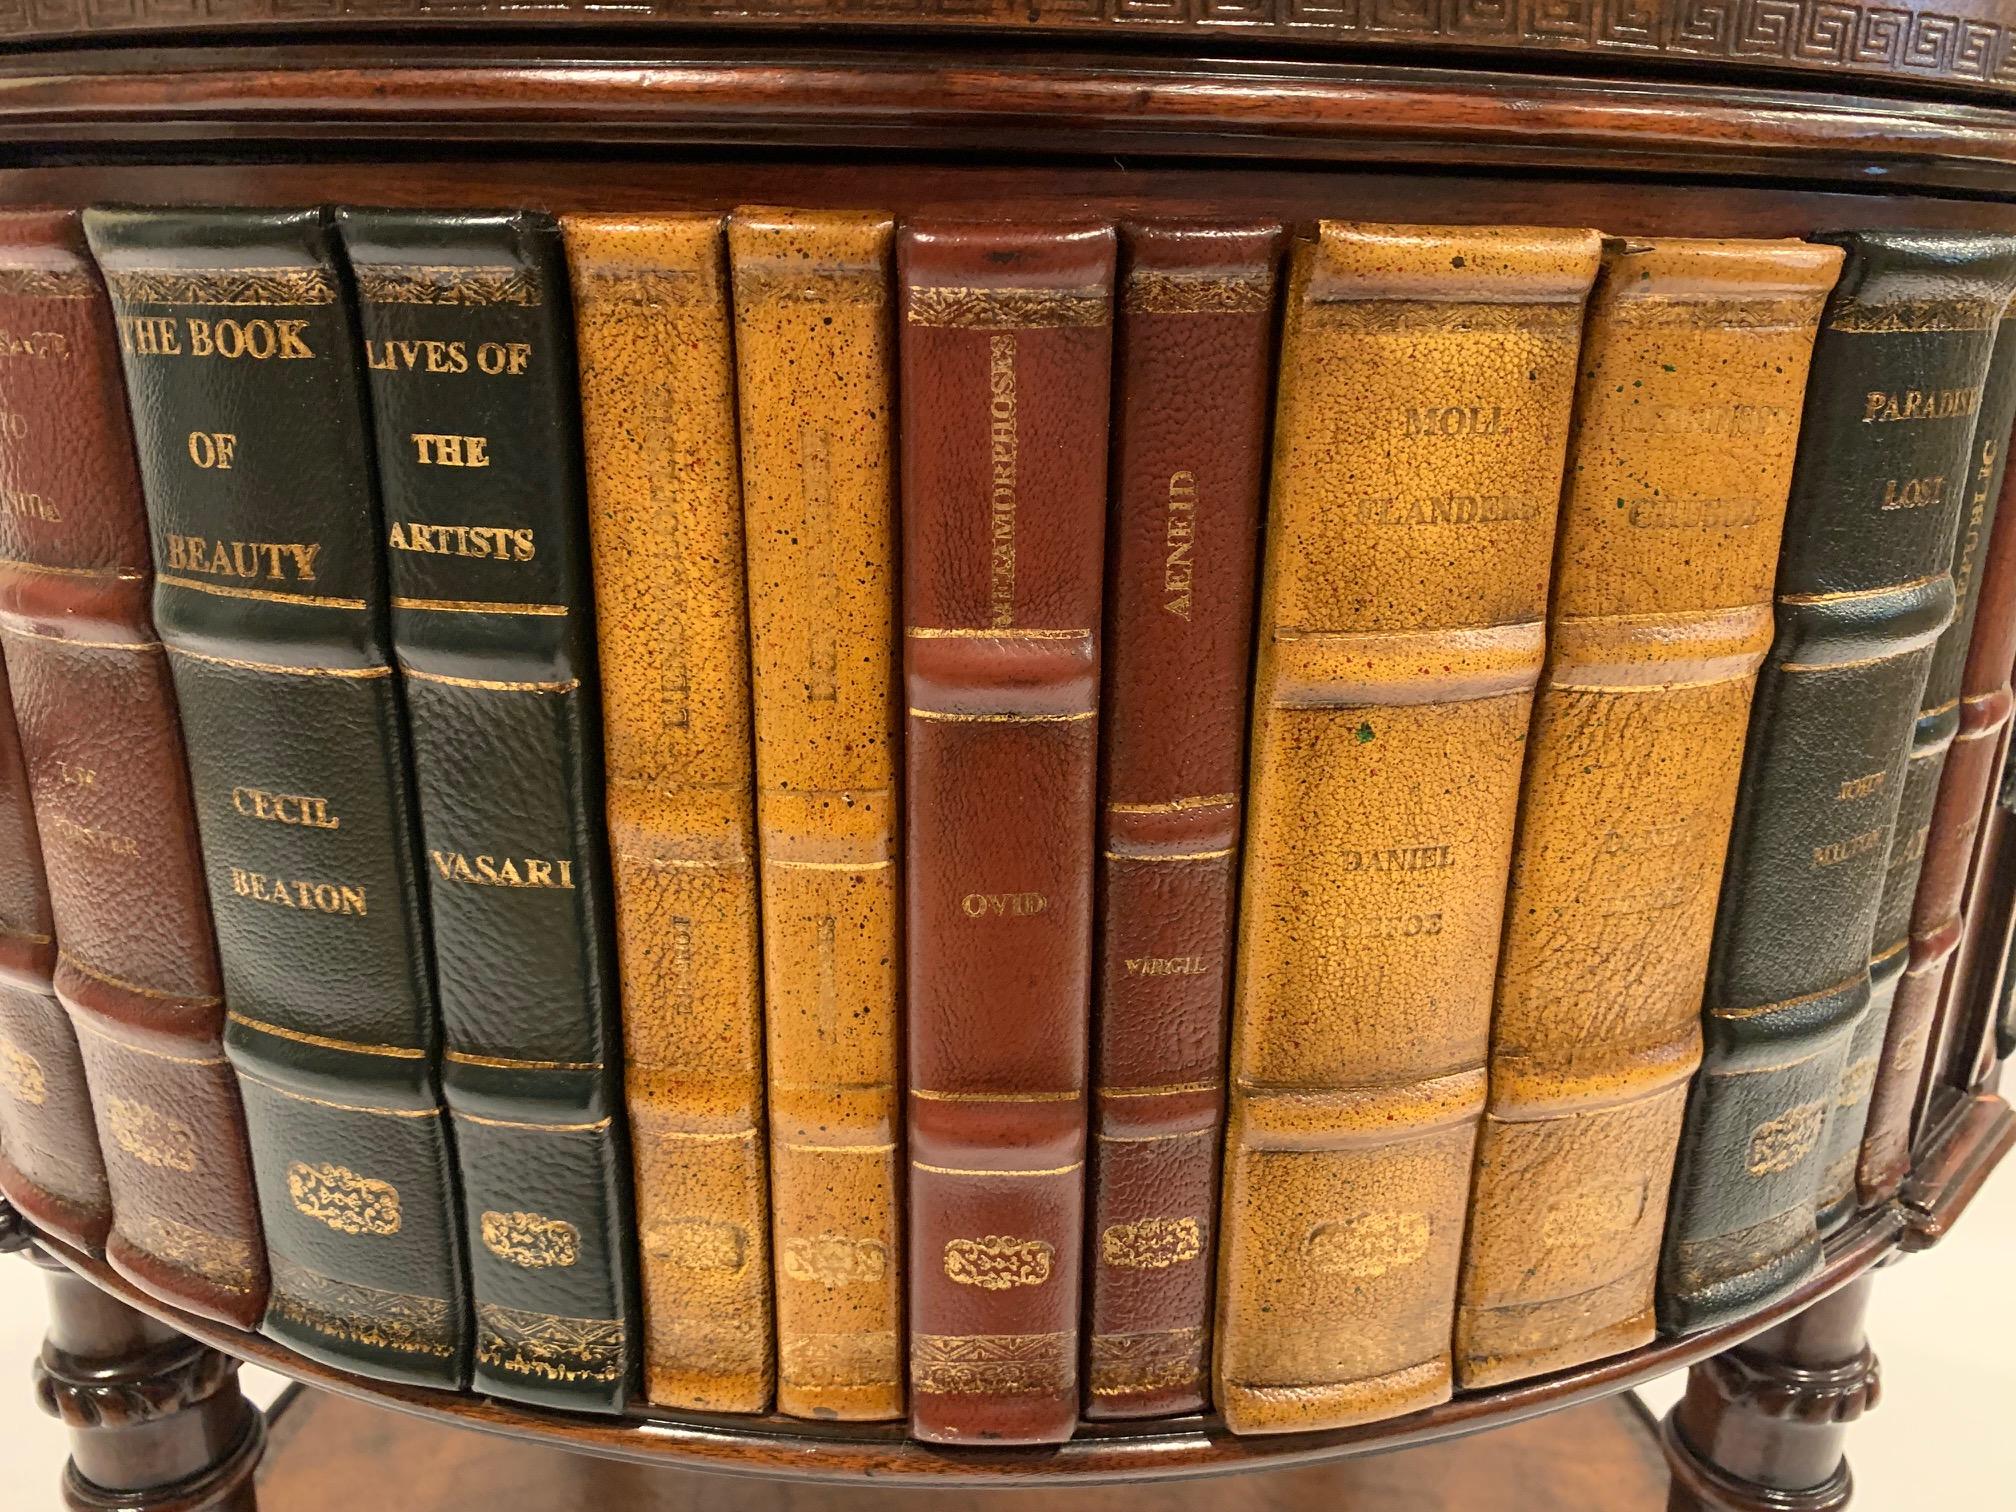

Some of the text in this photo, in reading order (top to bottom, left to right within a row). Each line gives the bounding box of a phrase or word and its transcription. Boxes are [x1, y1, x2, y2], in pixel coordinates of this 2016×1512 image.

[119, 317, 182, 356] THE
[186, 318, 317, 361] BOOK
[366, 340, 533, 377] LIVES OF
[188, 431, 237, 471] OF
[411, 433, 491, 468] THE
[1881, 476, 1946, 510] LOST
[166, 535, 322, 581] BEAUTY
[388, 522, 537, 563] ARTISTS
[1163, 469, 1200, 623] AENEID
[232, 786, 341, 830] CECIL
[428, 849, 576, 890] VASARI
[1341, 845, 1456, 873] DANIEL
[231, 867, 368, 917] BEATON
[961, 891, 1048, 919] OVID
[1124, 956, 1208, 977] VIRGIL
